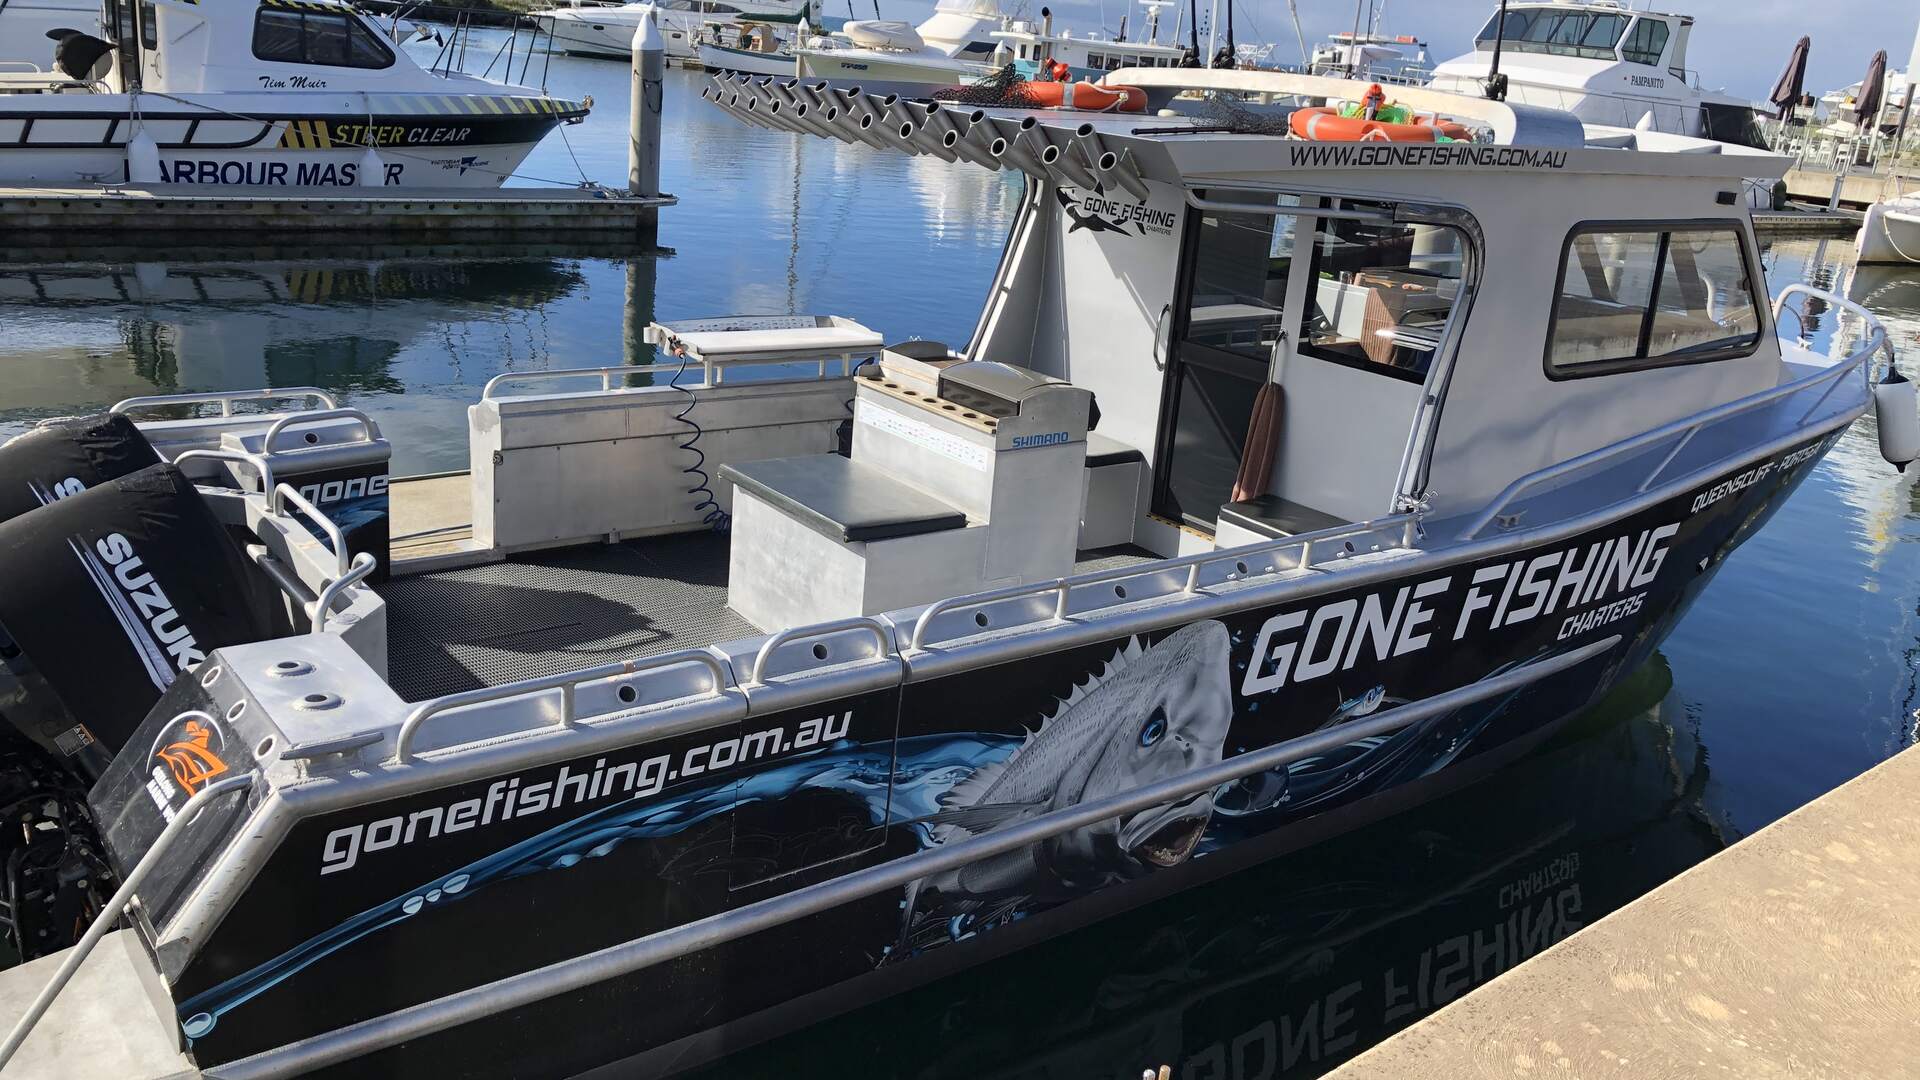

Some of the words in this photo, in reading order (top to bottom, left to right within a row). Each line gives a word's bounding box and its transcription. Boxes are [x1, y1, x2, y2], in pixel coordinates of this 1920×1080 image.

[259, 76, 286, 89] Tim
[289, 76, 327, 89] Muir
[1631, 75, 1665, 89] PAMPANITO
[335, 124, 405, 144] STEER
[407, 127, 471, 143] CLEAR
[1290, 146, 1567, 168] WWW.GONEFISHING.COM.AU
[124, 159, 288, 185] ARBOUR
[296, 163, 404, 185] MASR
[1084, 197, 1119, 216] GONE
[1121, 203, 1176, 228] FISHING
[1146, 225, 1172, 236] CHARTERS
[1012, 431, 1069, 448] SHIMANO
[1690, 462, 1775, 514] QUEENSCLIFF
[96, 533, 206, 671] SUZUK
[1242, 576, 1452, 697] GONE
[1453, 522, 1681, 641] FISHING
[1557, 591, 1648, 640] CHARTERS
[320, 710, 853, 876] gonefishing.com.au
